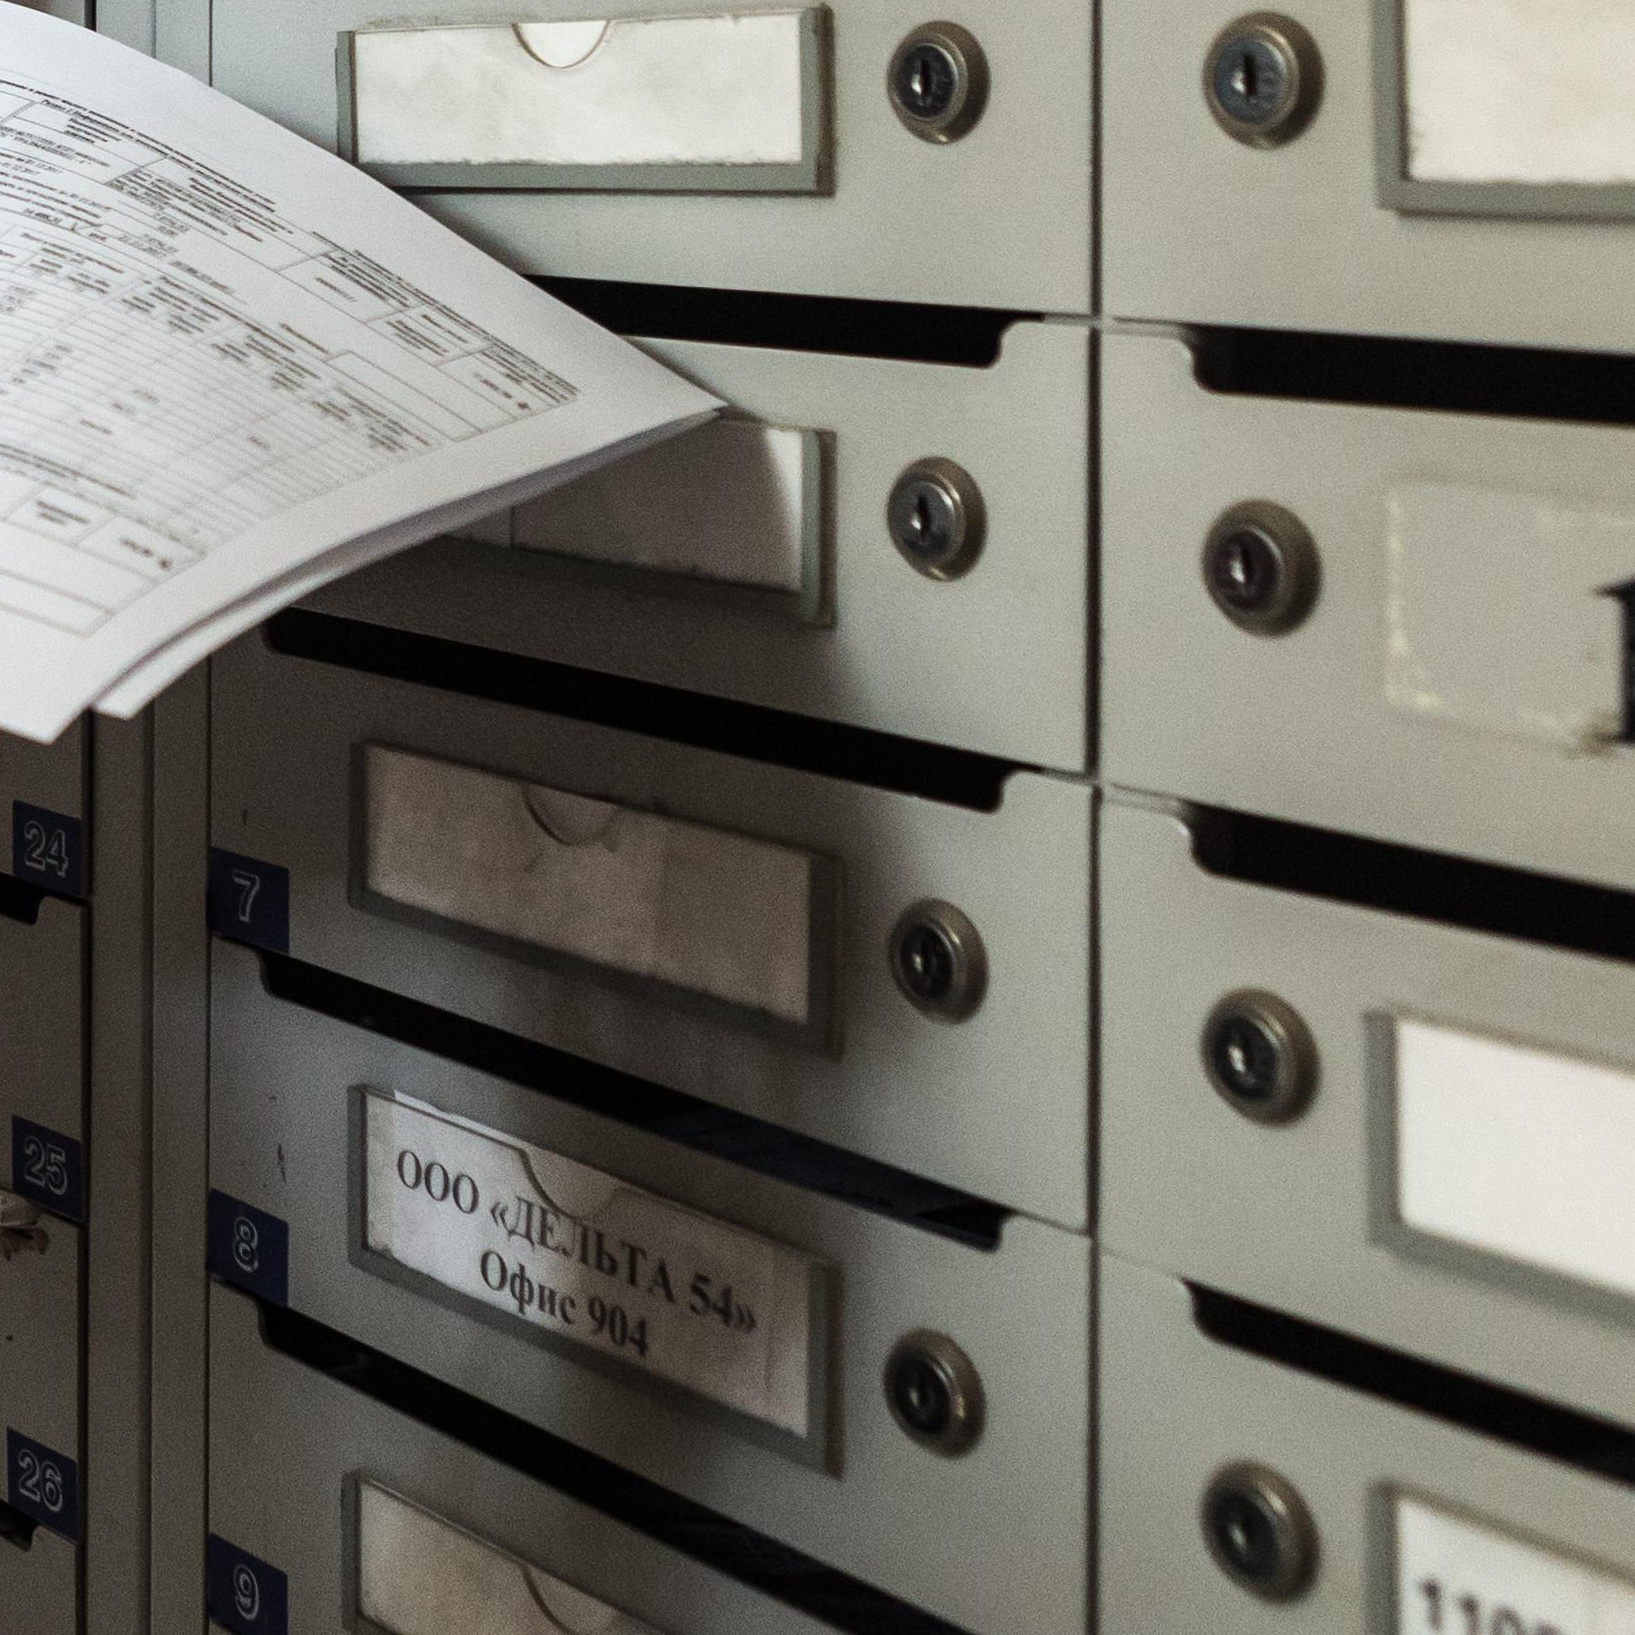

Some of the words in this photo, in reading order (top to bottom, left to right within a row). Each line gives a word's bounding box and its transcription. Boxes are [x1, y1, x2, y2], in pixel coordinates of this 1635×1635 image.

[24, 821, 69, 878] 24
[231, 869, 261, 924] 7
[24, 1136, 69, 1195] 25
[232, 1216, 261, 1274] 8
[396, 1148, 481, 1216] ООО
[489, 1193, 675, 1303] «ДЕЛЬТА
[689, 1276, 757, 1335] 54»
[479, 1250, 578, 1326] Офис
[586, 1301, 651, 1356] 904
[18, 1449, 64, 1513] 26
[233, 1563, 261, 1621] 9
